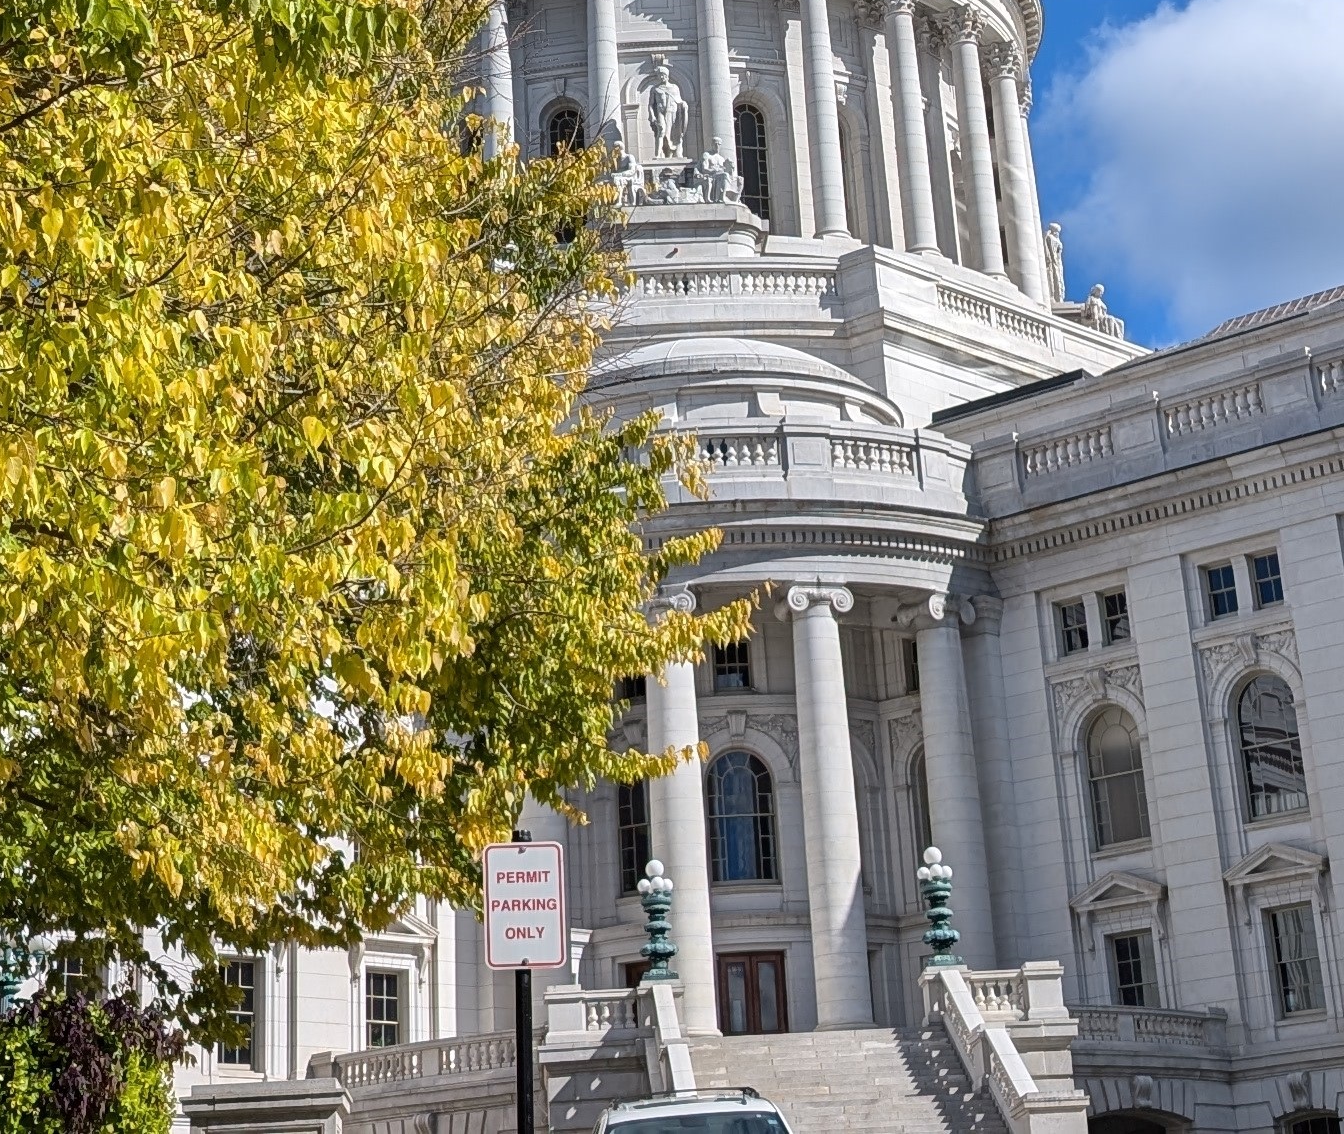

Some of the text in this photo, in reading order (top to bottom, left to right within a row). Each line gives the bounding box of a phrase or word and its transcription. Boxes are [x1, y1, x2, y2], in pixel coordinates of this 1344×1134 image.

[496, 871, 551, 884] PERMIT
[491, 898, 557, 911] PARKING
[505, 926, 545, 939] ONLY
